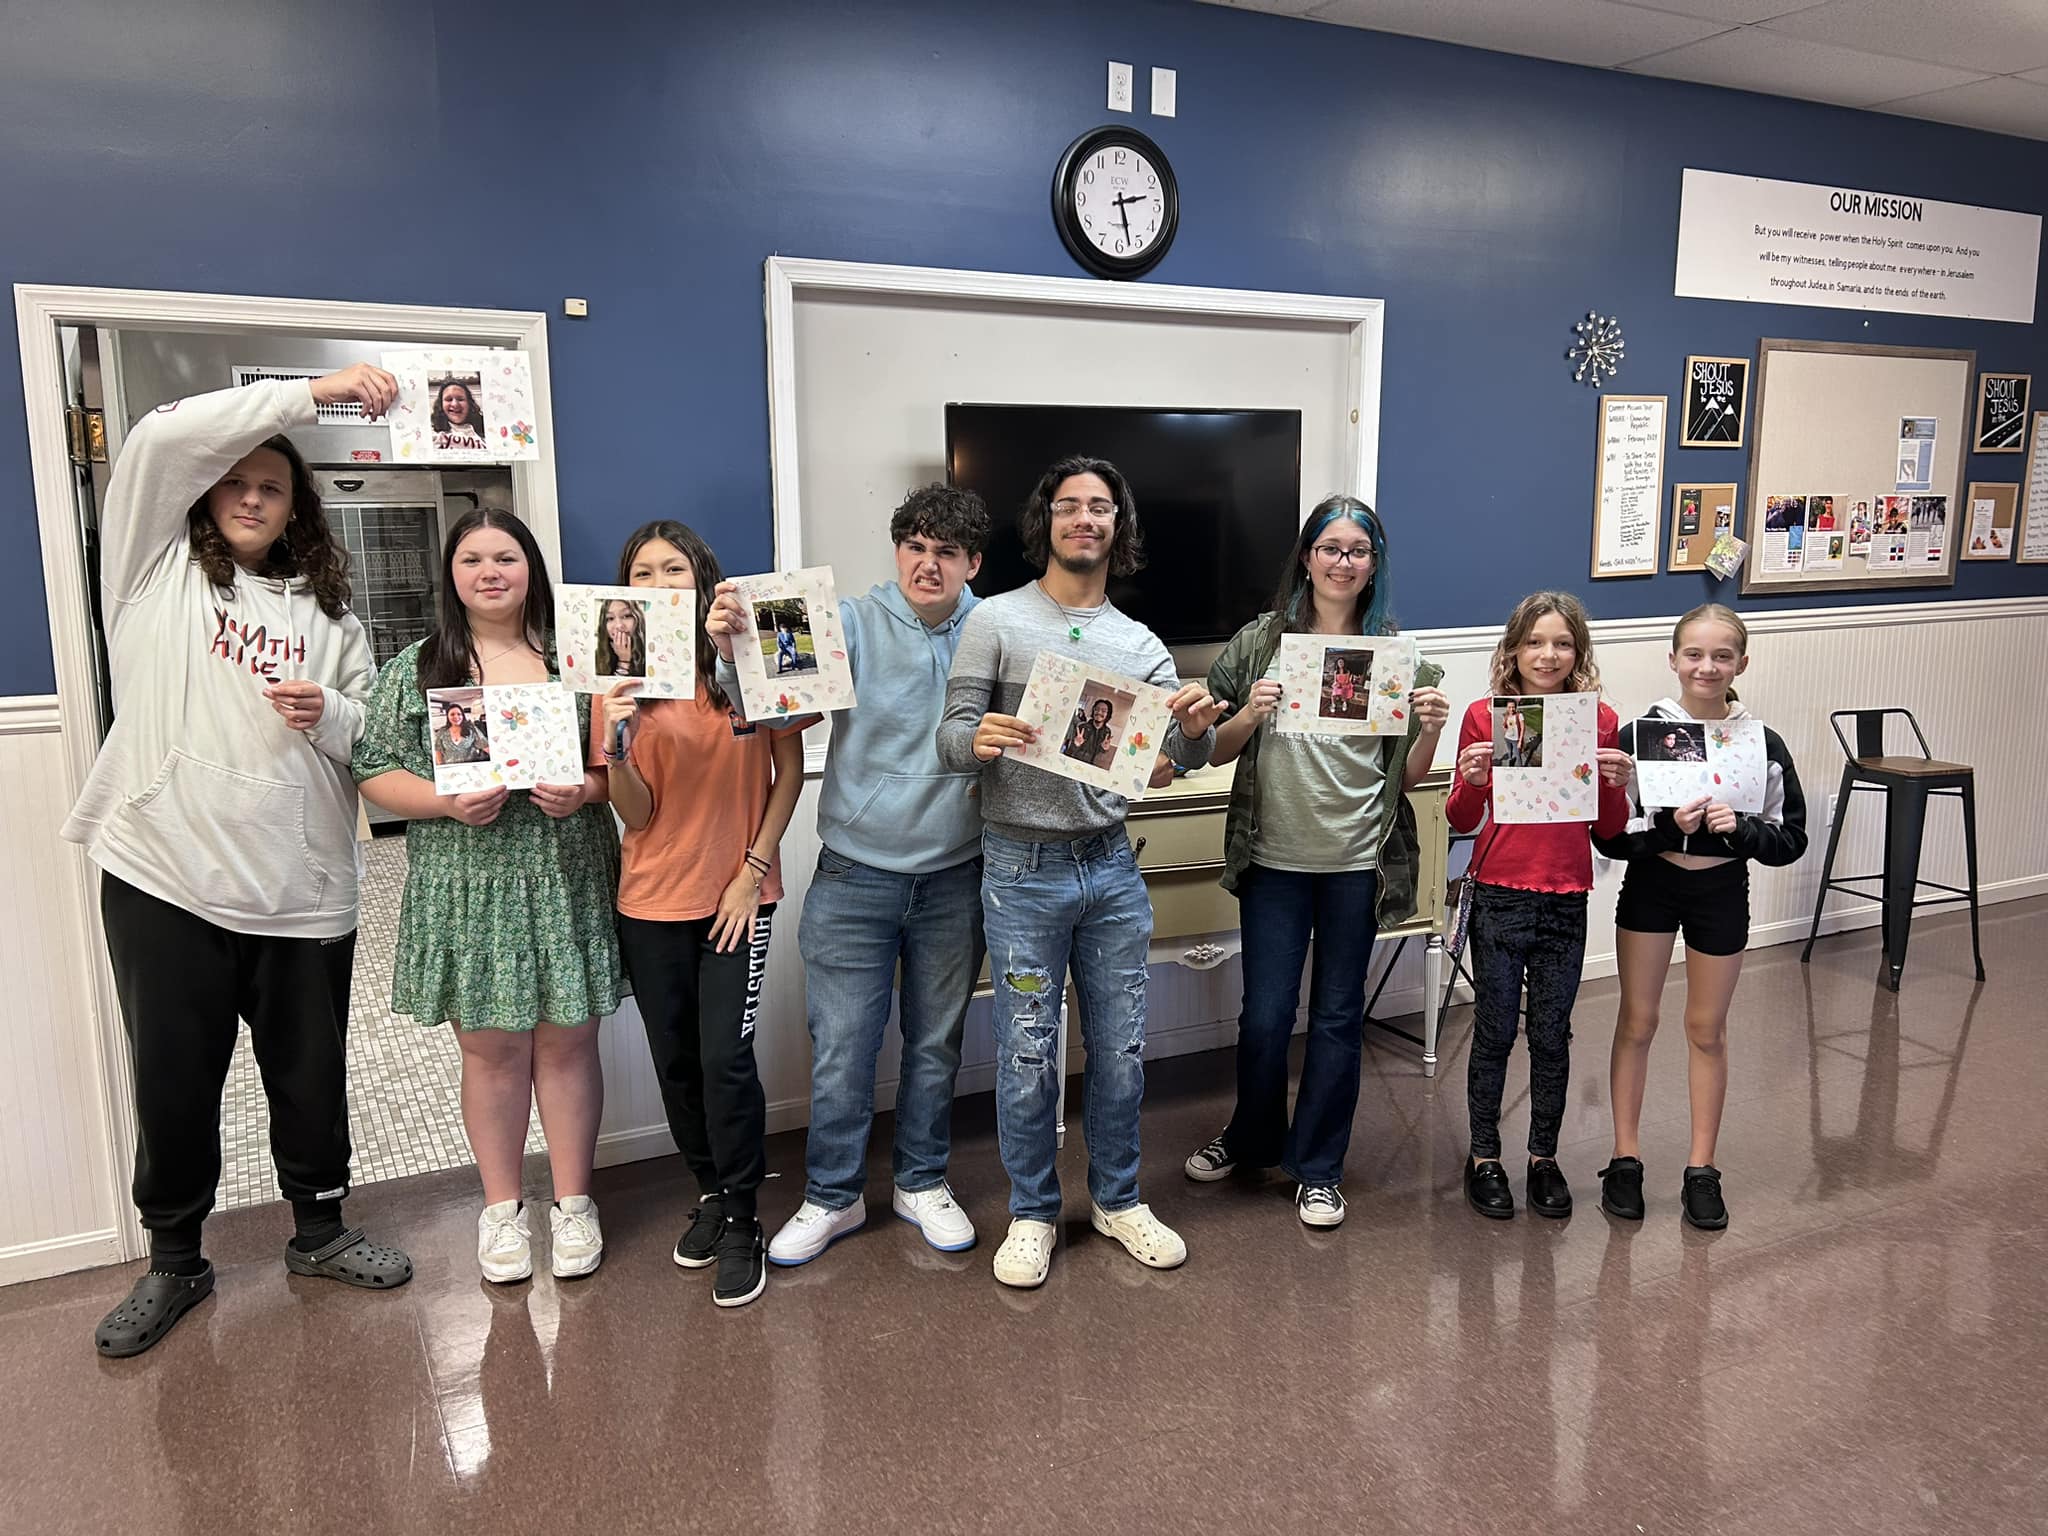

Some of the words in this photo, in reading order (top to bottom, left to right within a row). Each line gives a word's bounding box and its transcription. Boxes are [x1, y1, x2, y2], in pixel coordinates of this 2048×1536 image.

[1097, 154, 1105, 169] 11
[1114, 150, 1126, 165] 12
[1136, 159, 1140, 172] 1
[1083, 170, 1095, 184] 10
[1110, 176, 1128, 185] ECW
[1147, 175, 1156, 190] 2
[1076, 192, 1086, 207] 9
[1153, 198, 1161, 213] 3
[1830, 192, 1862, 214] OUR
[1864, 196, 1923, 222] MISSION
[1084, 214, 1092, 230] 8
[1146, 218, 1156, 232] 4
[1098, 232, 1107, 246] 7
[1115, 239, 1124, 254] 6
[1134, 234, 1142, 248] 5
[1754, 224, 1766, 235] But
[1768, 228, 1780, 238] you
[1782, 228, 1793, 238] will
[1794, 230, 1816, 240] receive
[1820, 233, 1842, 242] power
[1842, 234, 1860, 244] when
[1861, 236, 1871, 245] the
[1872, 236, 1886, 248] Holy
[1888, 237, 1904, 249] Spirit
[1906, 240, 1926, 250] comes
[1926, 244, 1940, 253] upon
[1955, 246, 1968, 256] And
[1968, 248, 1980, 258] you
[1759, 251, 1770, 262] will
[1771, 252, 1780, 262] be
[1780, 254, 1792, 265] my
[1828, 258, 1847, 270] telling
[1847, 260, 1868, 271] people
[1869, 260, 1886, 271] about
[1886, 264, 1896, 272] me
[1941, 269, 1946, 278] in
[1946, 269, 1974, 280] Jerusalem
[1770, 276, 1807, 290] throughout
[1829, 281, 1835, 291] in
[1864, 285, 1874, 294] and
[1875, 286, 1882, 295] to
[1884, 287, 1894, 296] the
[1895, 288, 1909, 298] ends
[1911, 288, 1919, 298] of
[1919, 289, 1929, 298] the
[1693, 362, 1730, 381] SHOUT
[1700, 380, 1734, 396] JESUS
[1986, 378, 2018, 399] SHOUT
[1990, 398, 2019, 415] JESUS
[214, 607, 306, 664] YOUTH
[210, 640, 282, 685] AIVE
